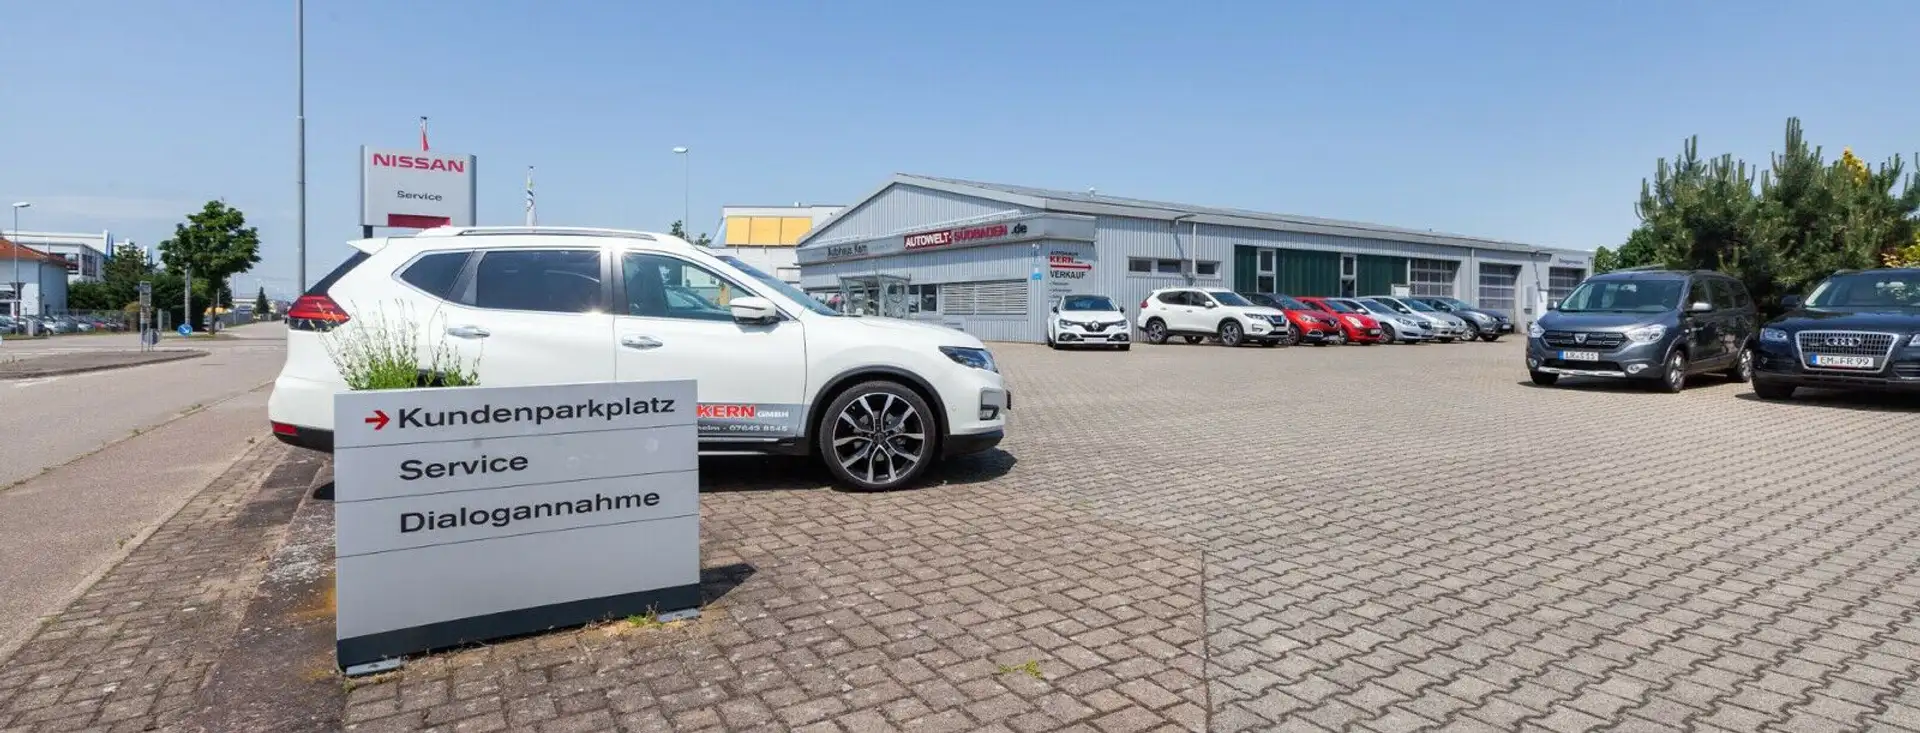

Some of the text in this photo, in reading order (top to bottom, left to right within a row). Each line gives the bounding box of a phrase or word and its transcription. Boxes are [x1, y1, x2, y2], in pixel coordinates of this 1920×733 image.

[373, 153, 465, 173] NISSAN
[397, 190, 442, 201] Service
[1050, 256, 1074, 264] KERN
[1050, 270, 1086, 280] VERKAUF
[399, 396, 676, 429] Kundenparkplatz
[697, 404, 756, 419] KERN
[399, 454, 529, 481] Service
[400, 490, 661, 533] Dialogannahme
